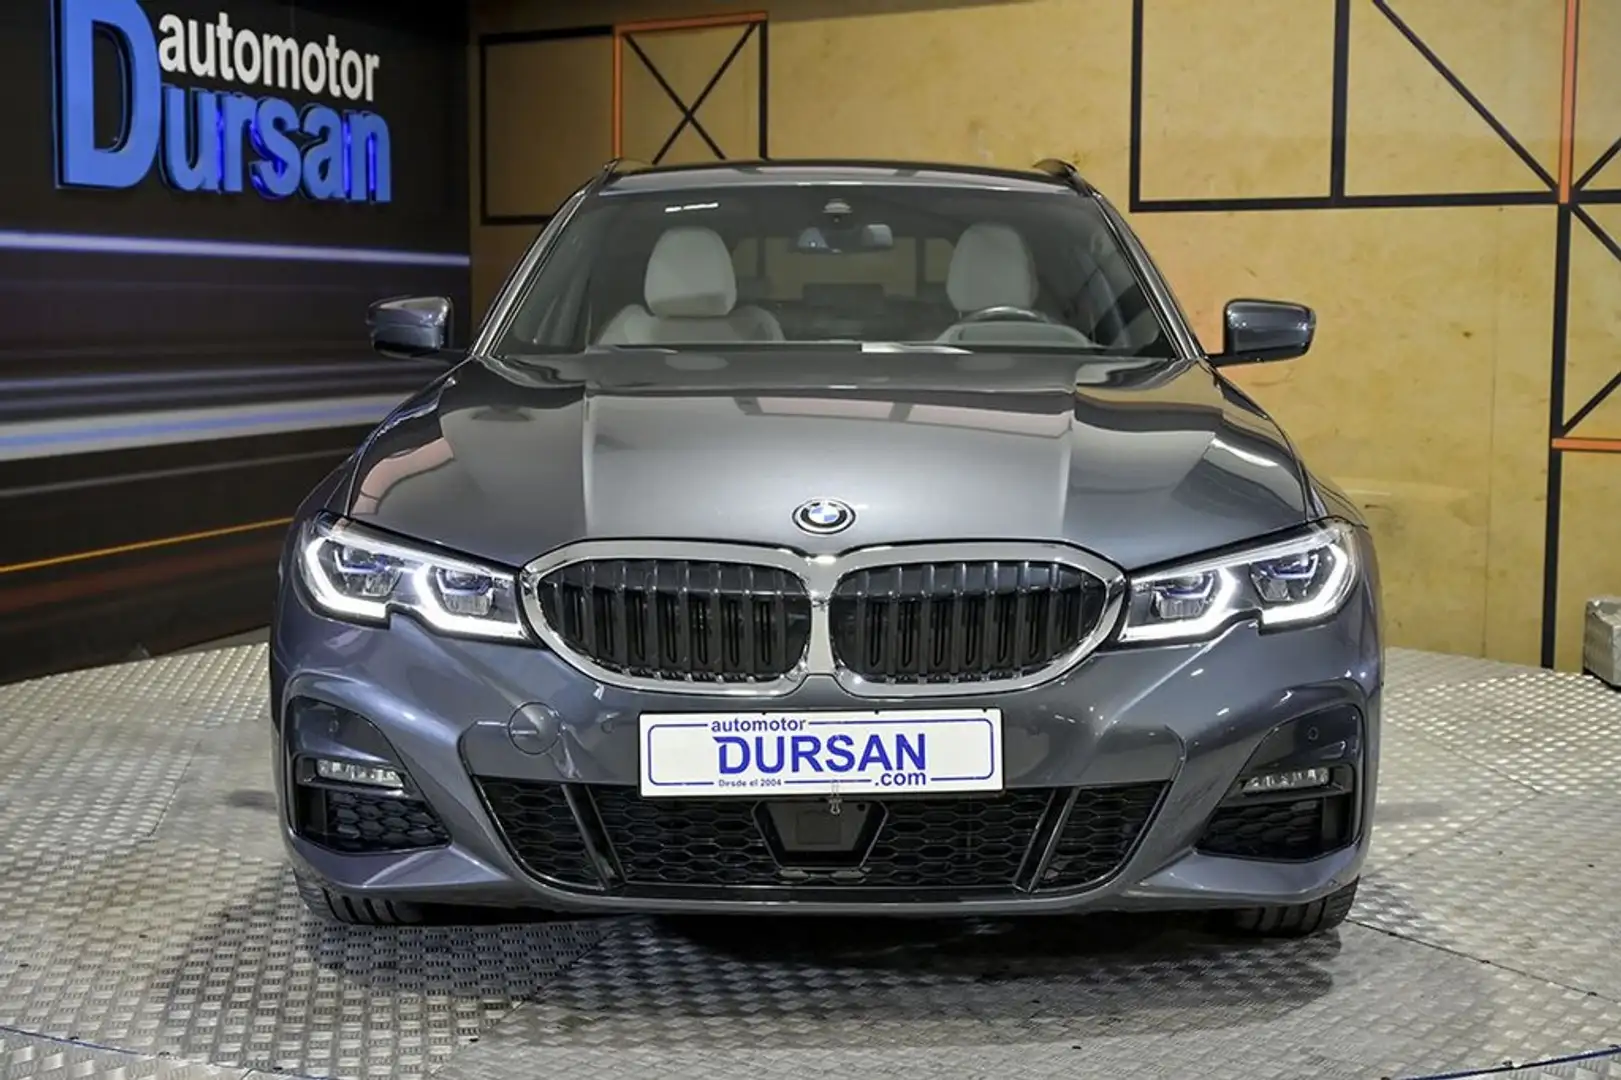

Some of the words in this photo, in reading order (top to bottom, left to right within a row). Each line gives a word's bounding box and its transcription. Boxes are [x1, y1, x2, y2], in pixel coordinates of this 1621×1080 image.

[158, 12, 380, 101] automotor
[53, 0, 391, 203] Dursan
[711, 717, 807, 732] automotor
[712, 733, 926, 774] DURSAN
[874, 772, 927, 787] .com
